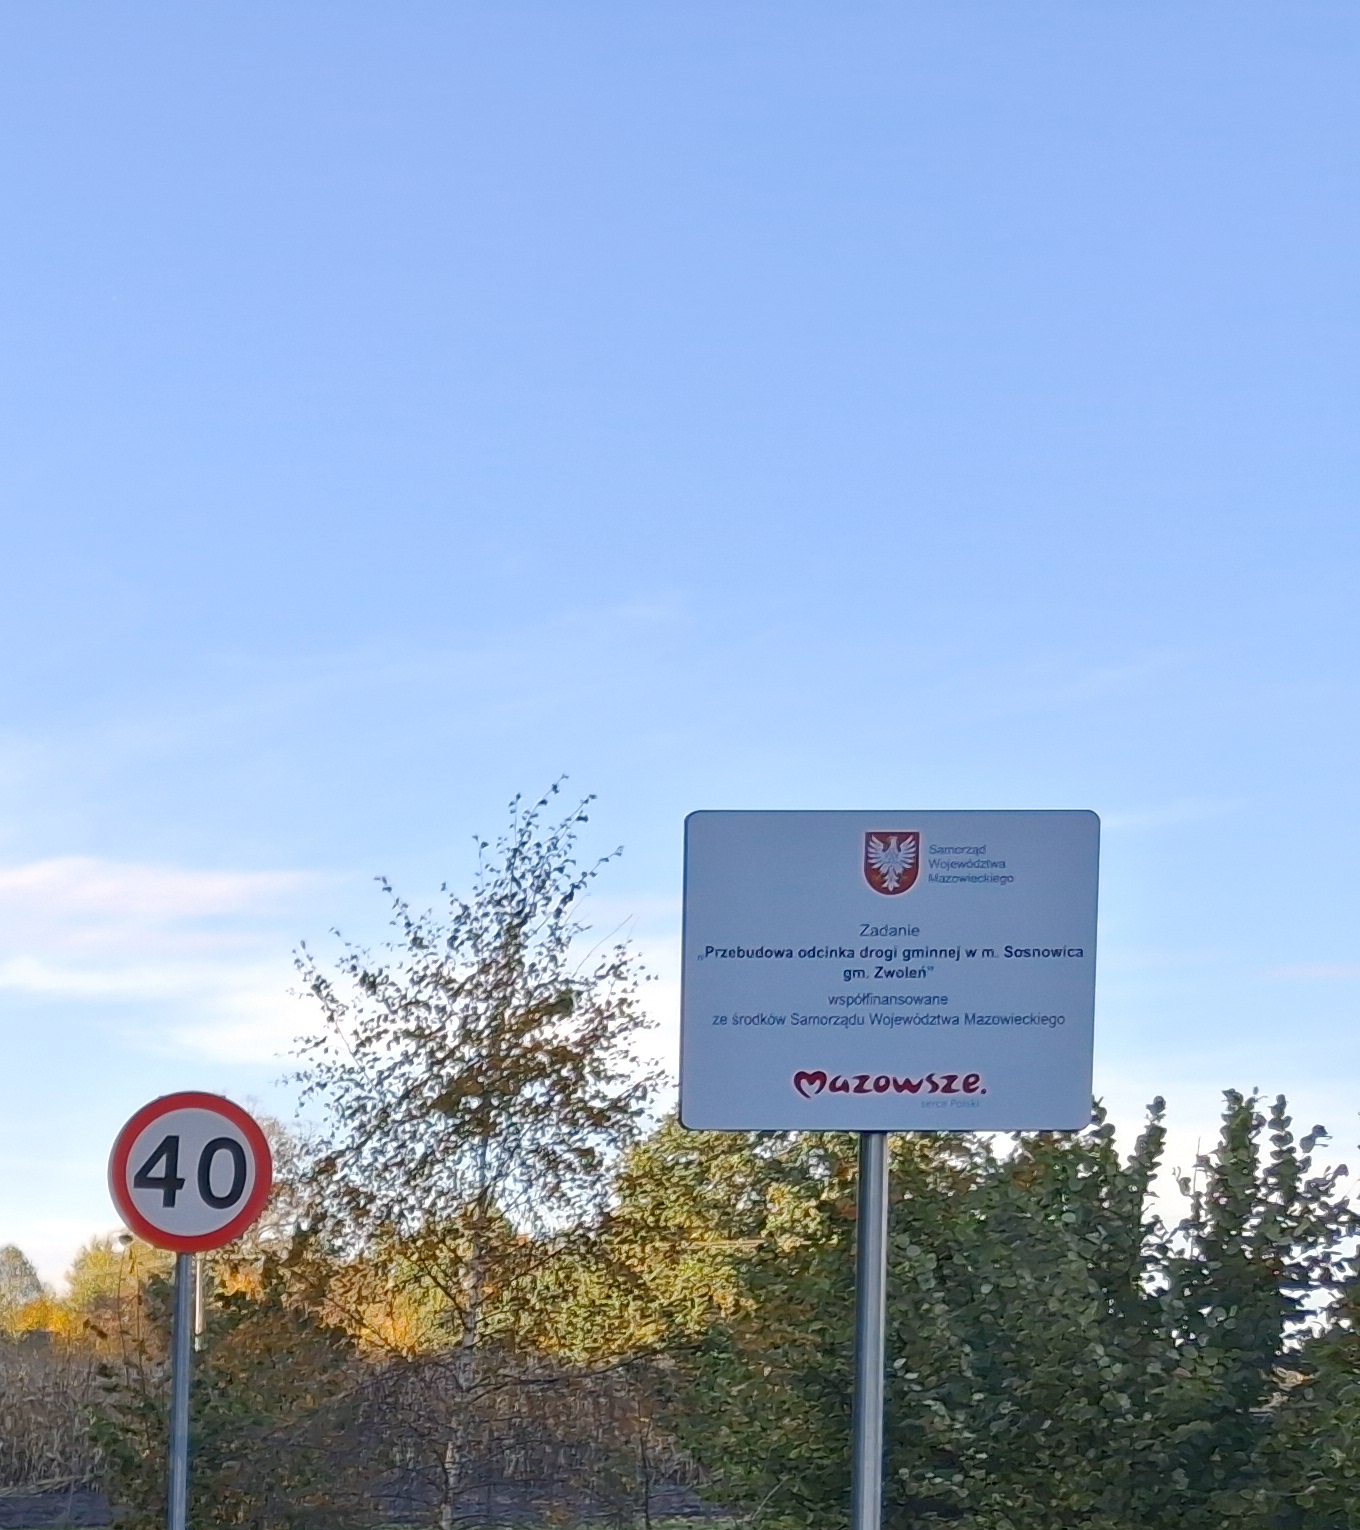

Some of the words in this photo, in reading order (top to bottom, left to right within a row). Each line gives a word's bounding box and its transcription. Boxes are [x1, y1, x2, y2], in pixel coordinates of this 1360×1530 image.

[860, 923, 919, 937] Zadanie
[798, 945, 855, 959] odcinka
[859, 945, 898, 961] drogi
[902, 945, 960, 961] gminnej
[965, 949, 977, 959] w
[981, 949, 999, 959] m.
[1004, 945, 1083, 959] Sosnowica
[843, 970, 870, 982] gm.
[828, 992, 948, 1008] współfinansowane
[712, 1016, 728, 1026] ze
[732, 1012, 786, 1026] środków
[790, 1012, 864, 1029] Samorządu
[869, 1012, 959, 1029] Województwa
[964, 1012, 1065, 1029] Mazowieckiego
[133, 1135, 247, 1209] 40
